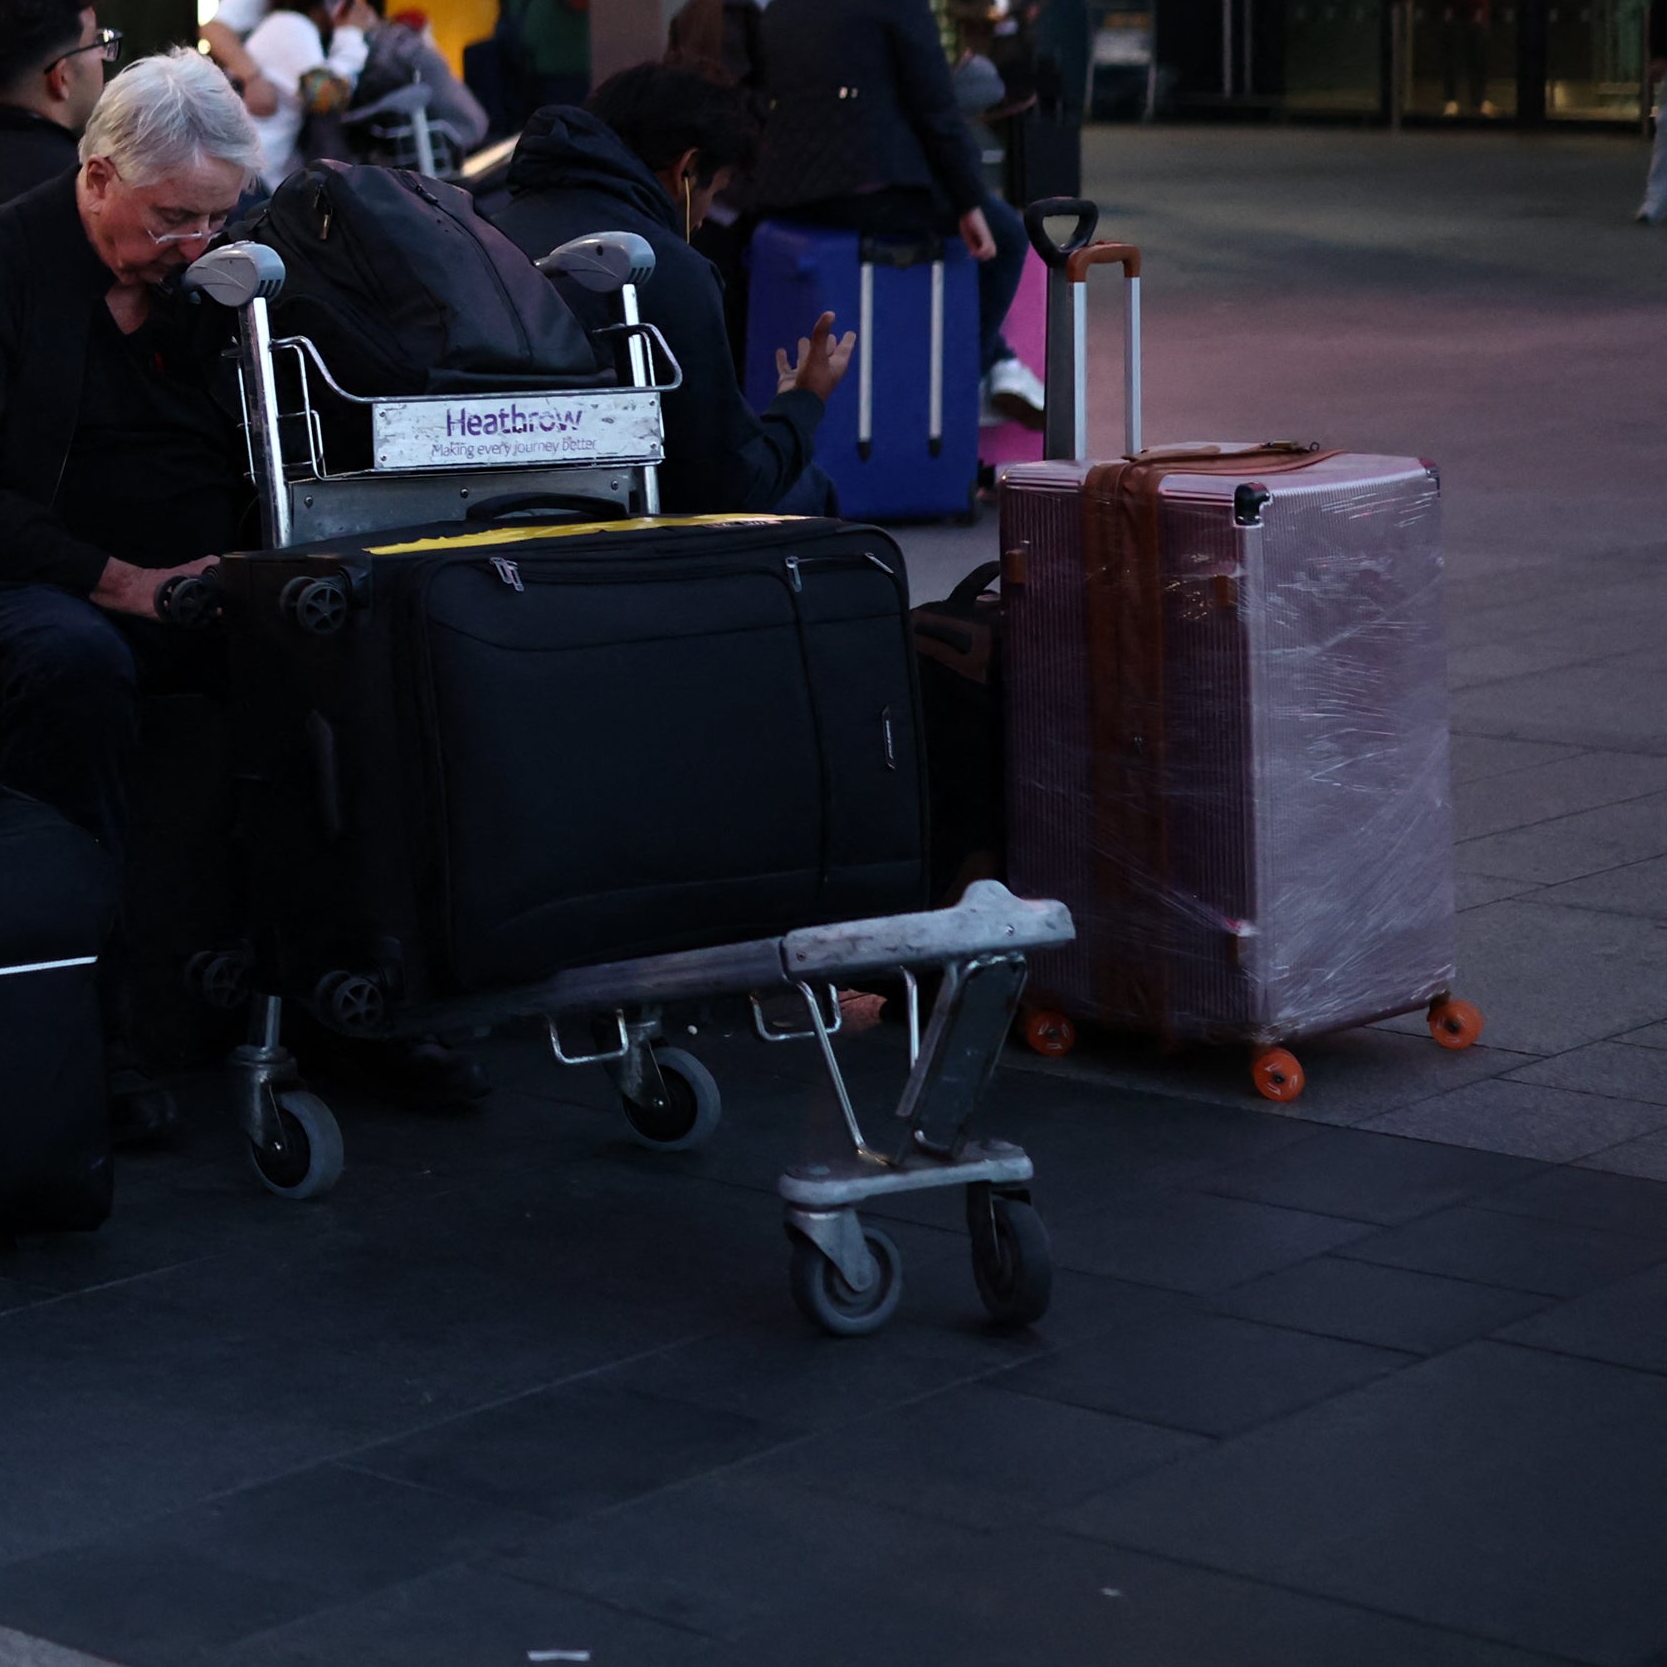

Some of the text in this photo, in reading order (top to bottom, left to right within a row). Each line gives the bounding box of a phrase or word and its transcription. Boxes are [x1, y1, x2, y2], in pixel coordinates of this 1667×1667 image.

[446, 403, 583, 437] Heathrow
[432, 437, 597, 458] Making every journey better
